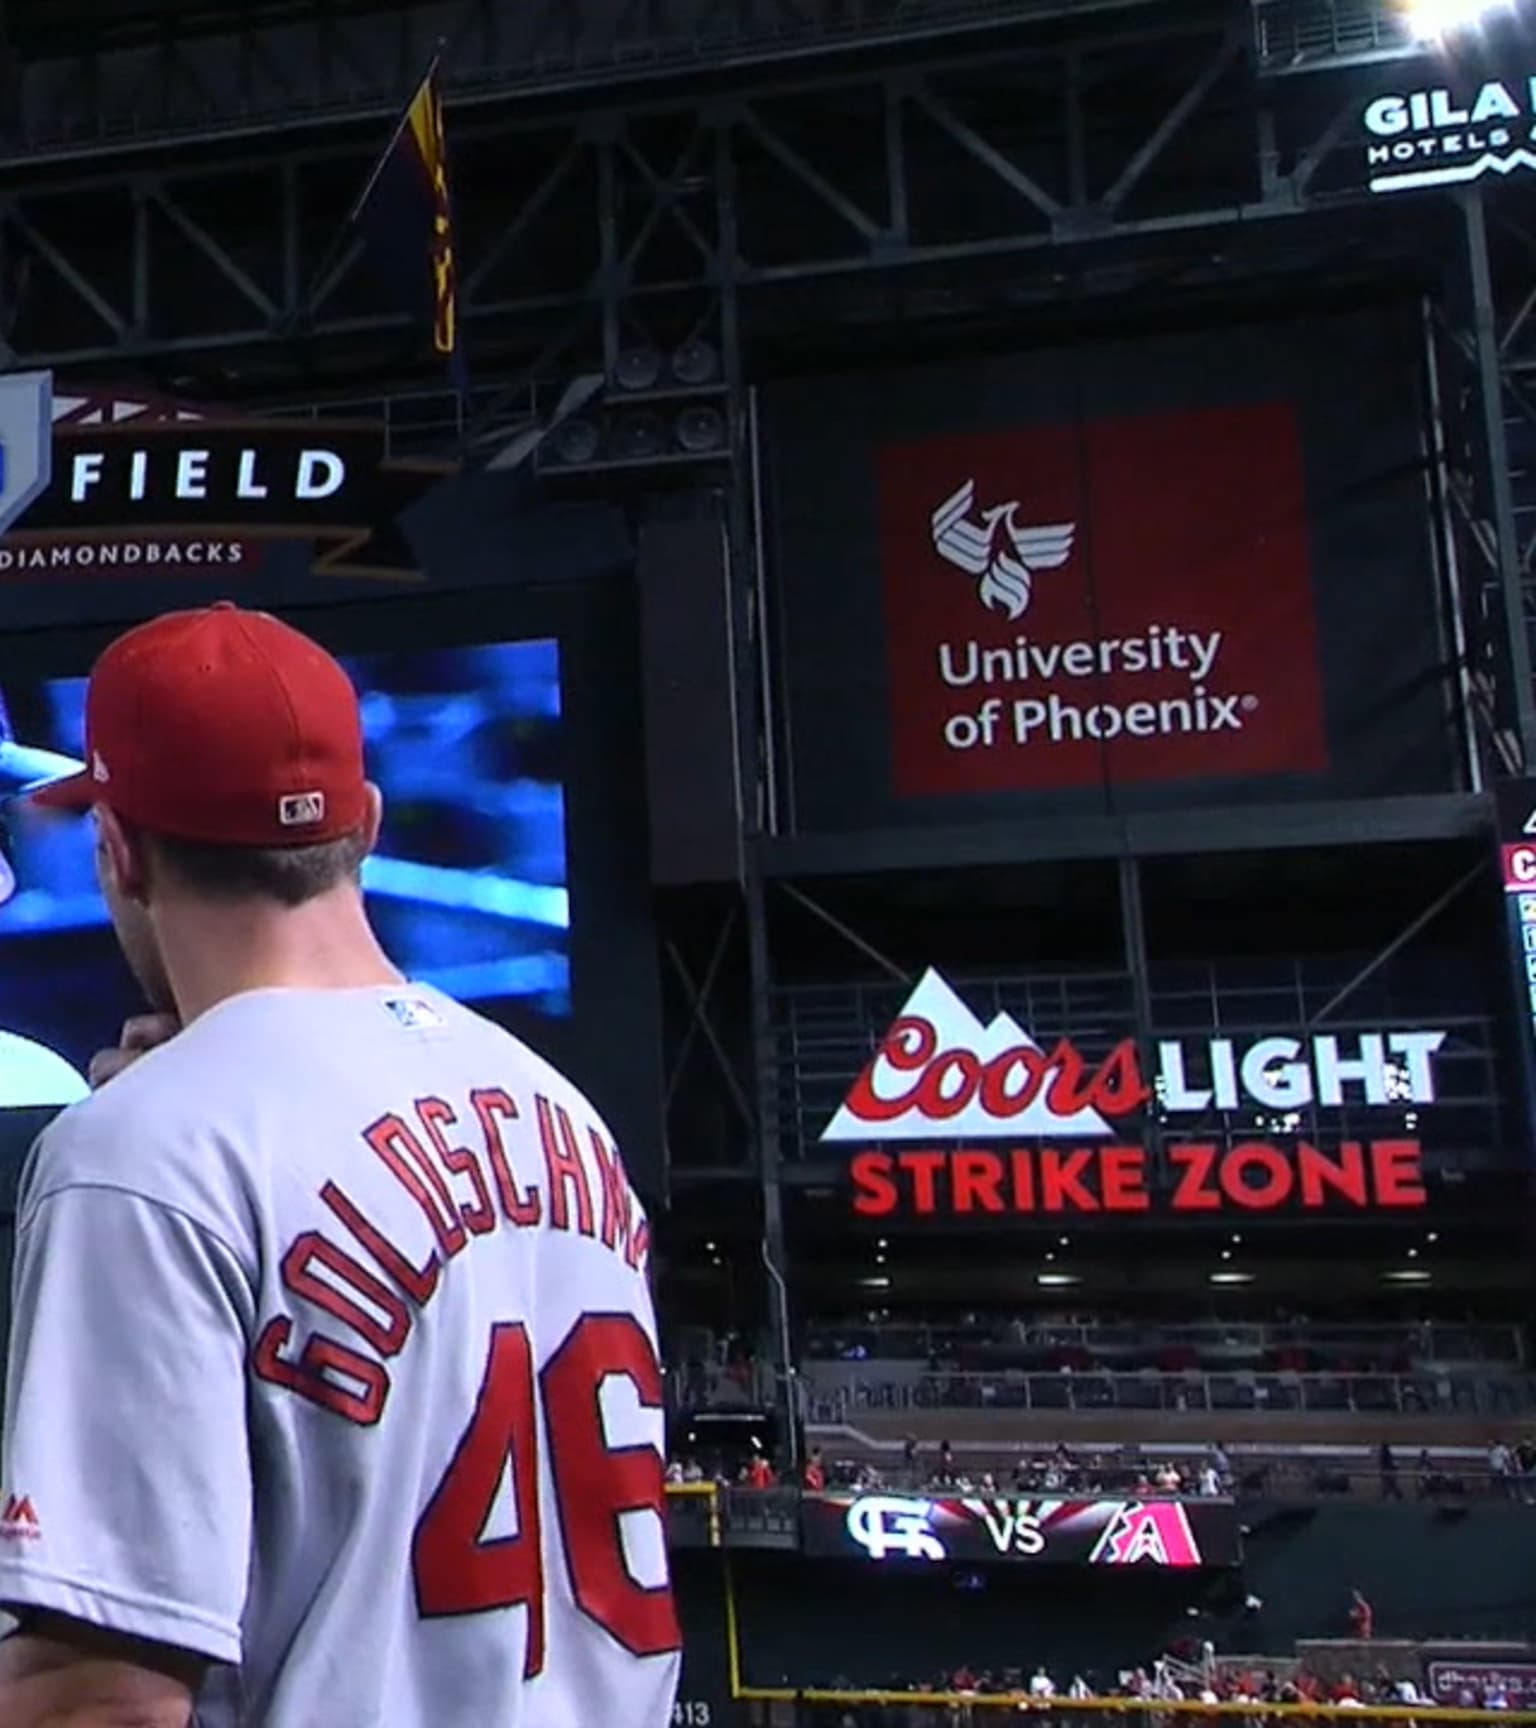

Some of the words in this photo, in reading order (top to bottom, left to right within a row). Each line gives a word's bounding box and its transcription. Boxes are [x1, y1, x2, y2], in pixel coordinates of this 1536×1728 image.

[1365, 81, 1520, 135] GILA
[1368, 128, 1509, 164] HOTELS
[71, 450, 346, 501] FIELD
[938, 624, 1222, 686] University
[944, 698, 1002, 749] of
[845, 1014, 1152, 1121] Coors
[1158, 1031, 1447, 1111] LIGHT
[849, 1143, 1149, 1213] STRIKE
[1169, 1139, 1427, 1209] ZONE
[413, 1311, 682, 1680] 46
[985, 1512, 1047, 1555] VS
